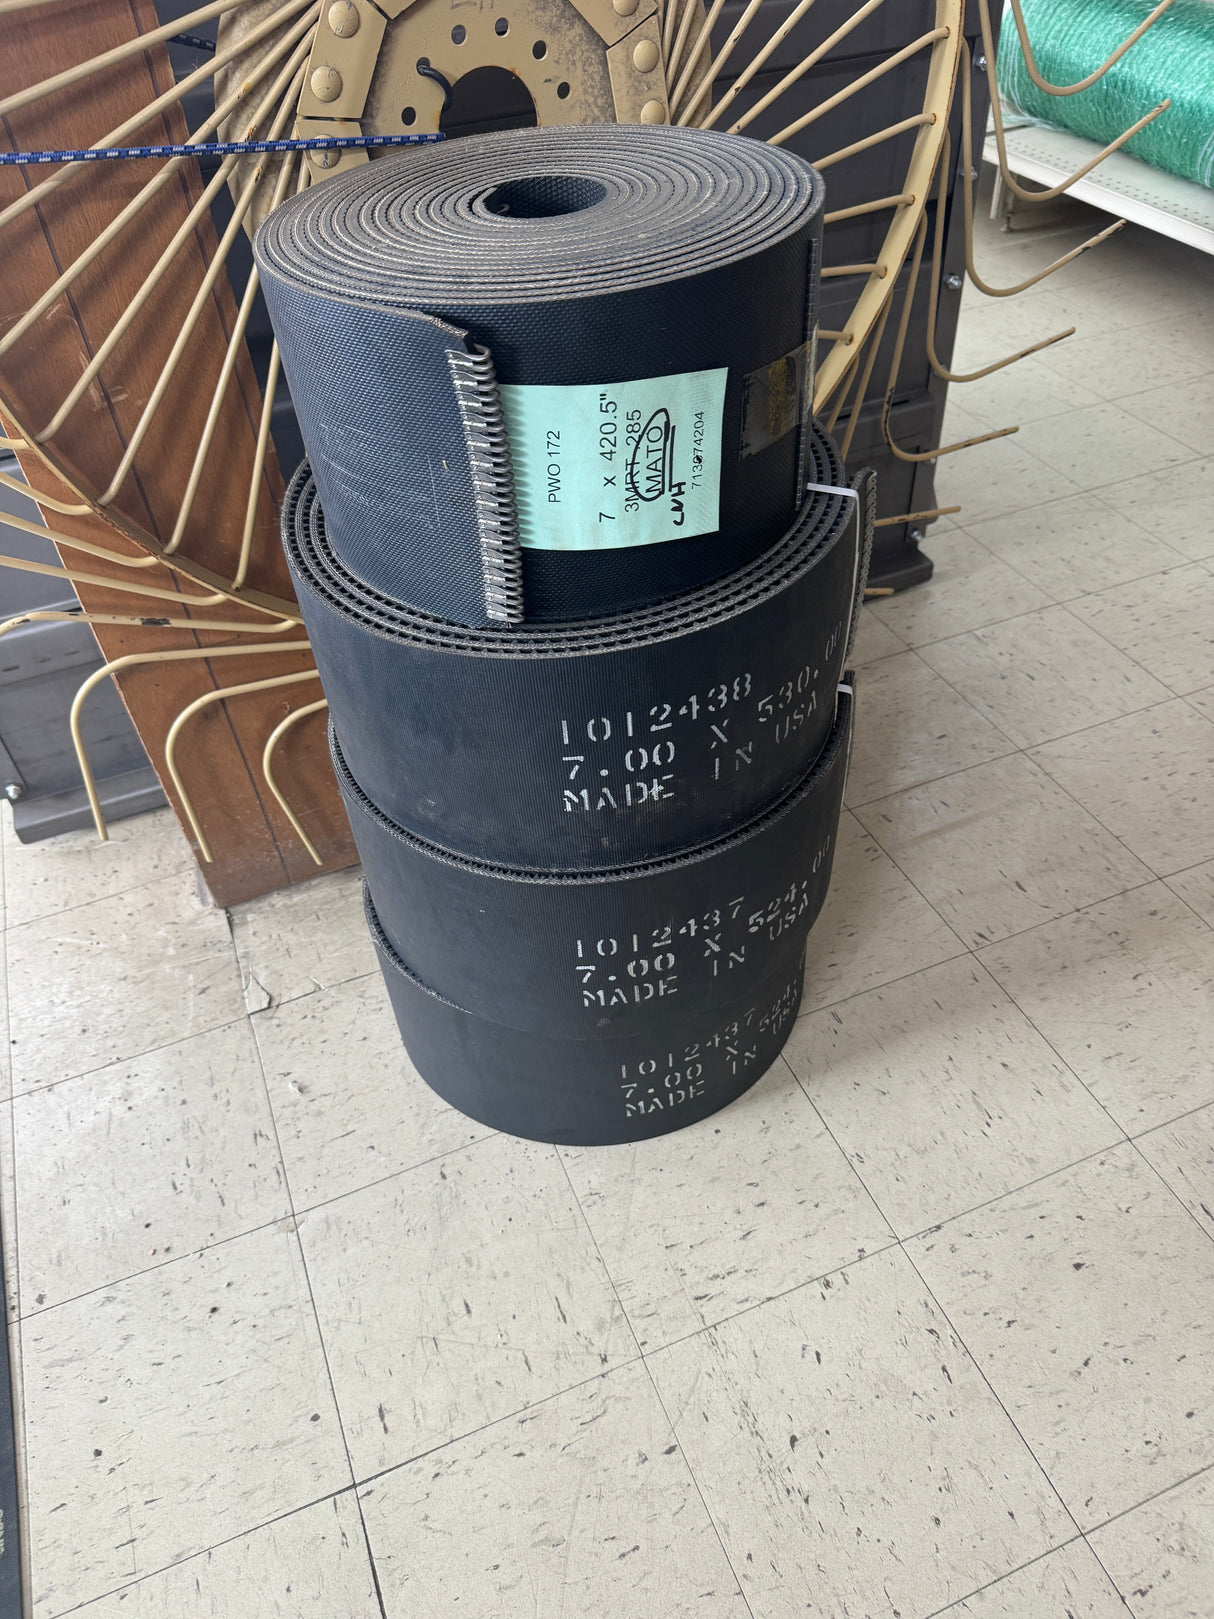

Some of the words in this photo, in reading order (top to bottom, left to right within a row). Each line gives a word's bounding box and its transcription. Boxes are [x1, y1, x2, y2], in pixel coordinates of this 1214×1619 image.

[546, 430, 561, 458] 172
[599, 392, 618, 462] 420.5"
[645, 424, 664, 493] MATO
[547, 463, 562, 503] PWO
[624, 459, 641, 513] 3MRT
[598, 512, 616, 523] 7
[561, 672, 752, 746] 1012438
[561, 741, 676, 781] 7.00
[562, 773, 676, 814] MADE
[713, 741, 753, 781] IN
[775, 690, 818, 744] USA
[576, 896, 745, 959] 1012437
[582, 975, 679, 1008] MADE
[712, 945, 747, 977] IN
[768, 892, 809, 942] USA
[574, 952, 676, 984] 7.00
[625, 1080, 706, 1118] MADE
[731, 1044, 758, 1076] IN
